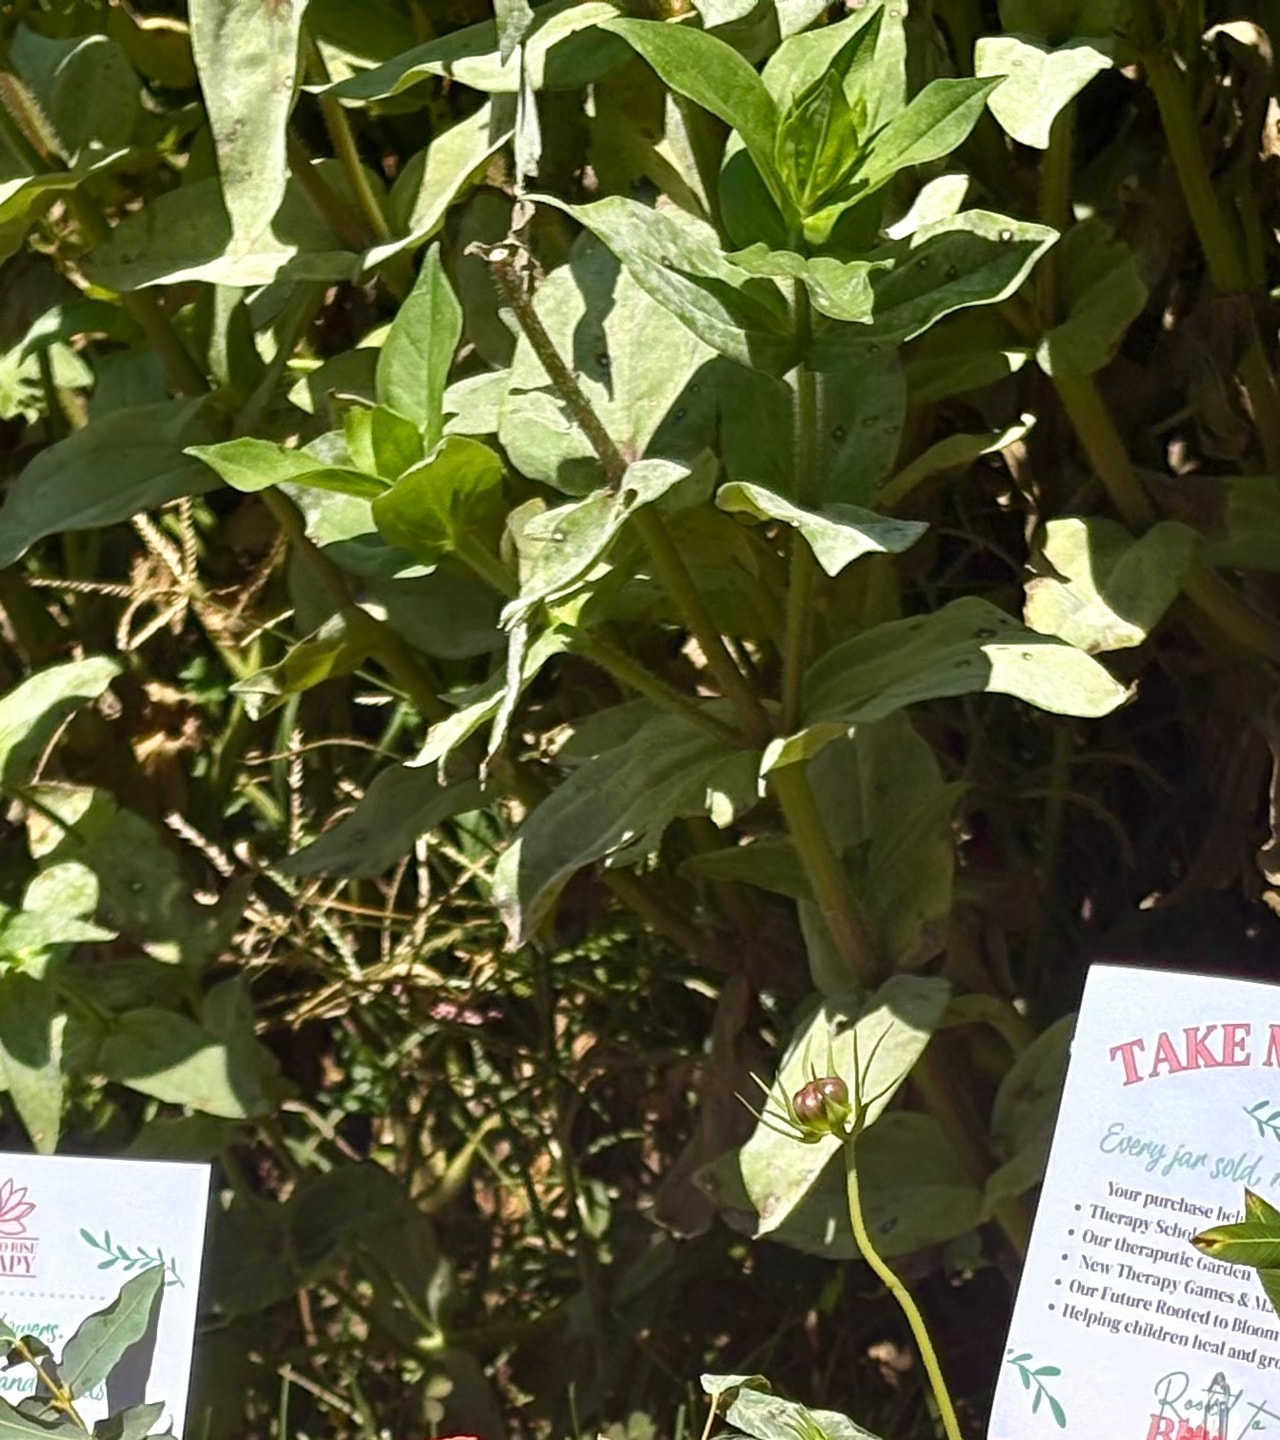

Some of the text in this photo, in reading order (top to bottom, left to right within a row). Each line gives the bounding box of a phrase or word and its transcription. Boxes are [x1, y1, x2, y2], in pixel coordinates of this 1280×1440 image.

[1108, 1022, 1253, 1087] TAKE
[1098, 1121, 1166, 1173] Every
[1163, 1144, 1208, 1177] jar
[1209, 1152, 1262, 1188] sold,
[1089, 1203, 1152, 1232] Therapy
[1106, 1180, 1143, 1203] Your
[1143, 1192, 1214, 1221] purchase
[10, 1241, 38, 1255] RISE
[1082, 1228, 1253, 1282] Our theraputic Garden
[1079, 1254, 1113, 1275] New
[1116, 1262, 1181, 1295] Therapy
[1183, 1279, 1236, 1304] Games
[1237, 1291, 1250, 1308] &
[1062, 1302, 1122, 1335] Helping
[1123, 1317, 1190, 1347] children
[1191, 1333, 1226, 1357] heal
[1227, 1344, 1258, 1364] and
[1069, 1277, 1099, 1299] Our
[1100, 1285, 1153, 1312] Future
[1155, 1298, 1211, 1326] Rooted
[1213, 1311, 1229, 1330] to
[1231, 1317, 1280, 1342] Bloom
